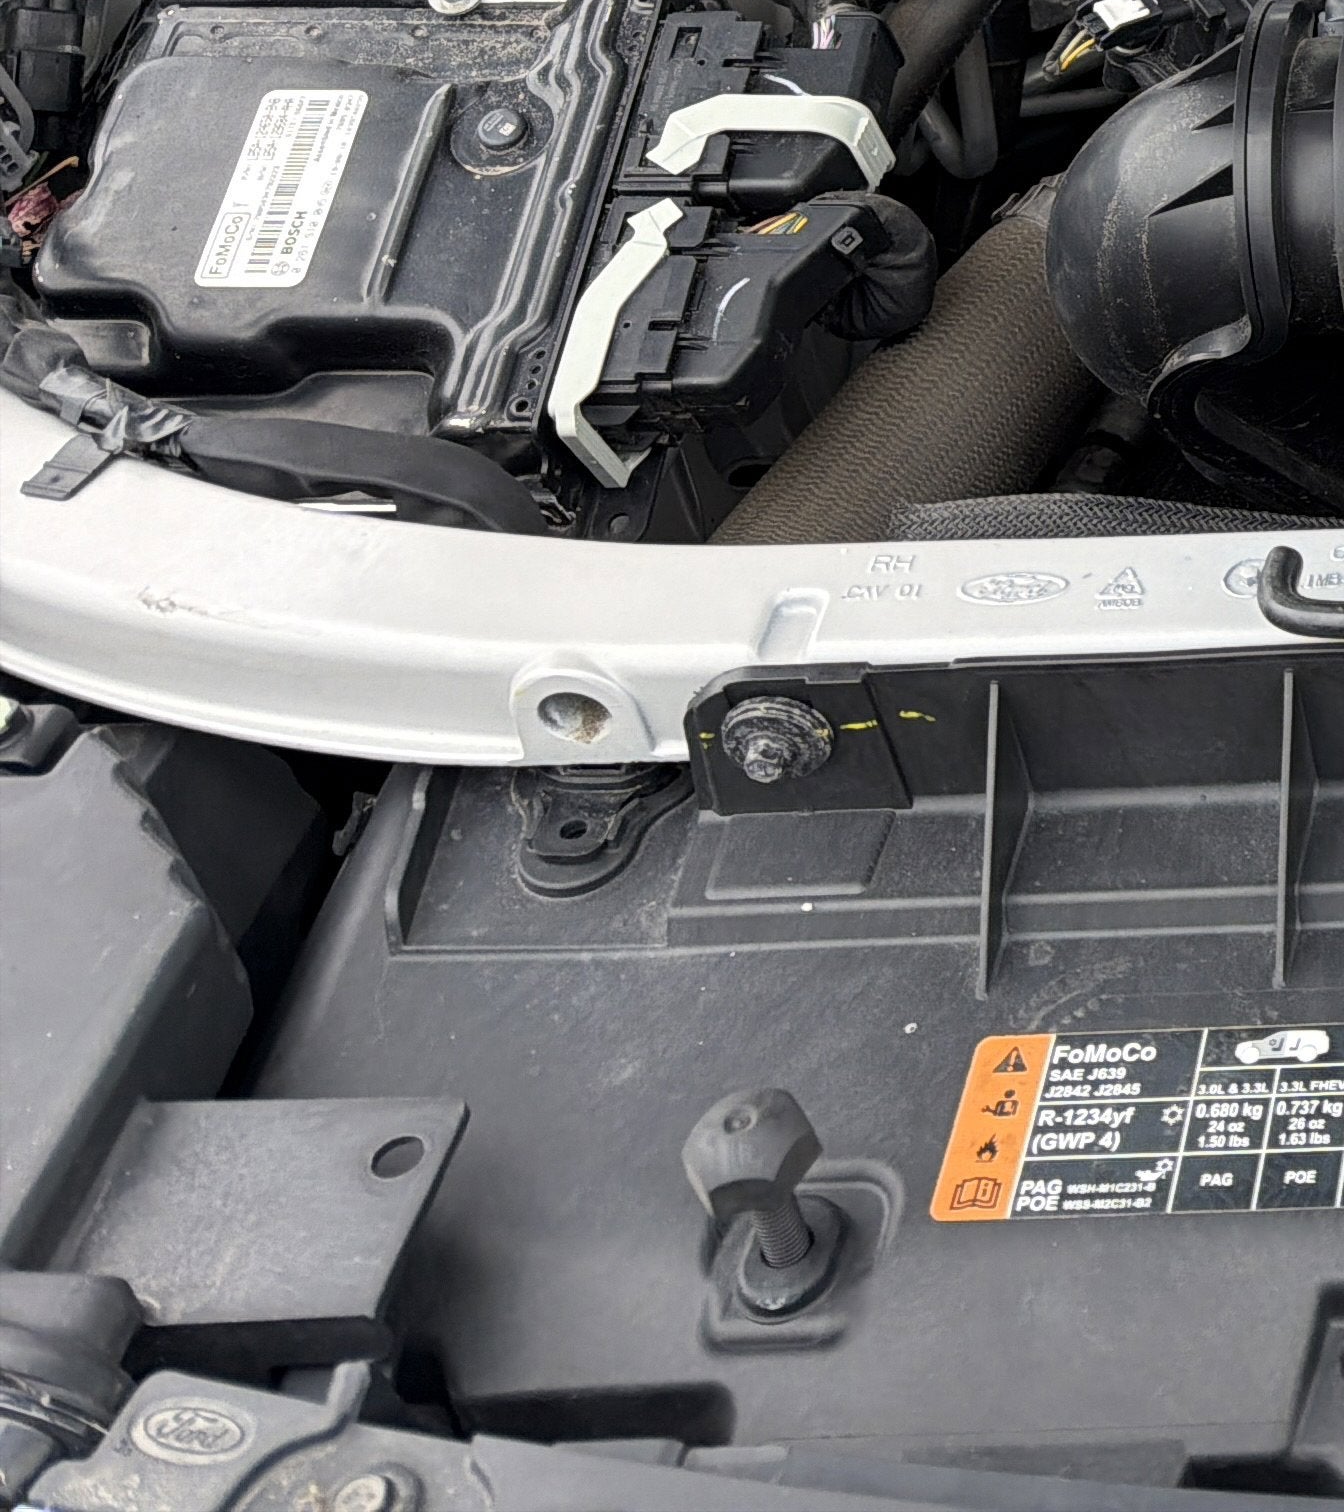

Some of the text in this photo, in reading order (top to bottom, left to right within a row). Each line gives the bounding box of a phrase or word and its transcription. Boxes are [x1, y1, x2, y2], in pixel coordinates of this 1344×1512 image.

[280, 210, 308, 255] BOSCH
[208, 215, 245, 275] FoMoCo
[869, 553, 917, 572] RH
[1052, 1042, 1157, 1065] FoMoCo
[1049, 1066, 1127, 1082] SAE J639
[1044, 1083, 1142, 1098] J2842 J2845
[1198, 1081, 1270, 1095] 3.0L & 3.3L
[1279, 1080, 1307, 1093] 3.3L
[1194, 1101, 1264, 1121] 0.680 kg
[1276, 1099, 1344, 1118] 0.737 kg
[1037, 1106, 1136, 1129] R-1234yf
[1286, 1117, 1327, 1131] 26 oz
[1206, 1120, 1246, 1134] 24 oz
[1031, 1131, 1121, 1155] (GWP 4)
[1197, 1134, 1251, 1148] 1.50 lbs
[1278, 1131, 1332, 1146] 1.63 lbs
[1199, 1172, 1234, 1187] PAG
[1282, 1169, 1318, 1185] POE
[1020, 1179, 1063, 1195] PAG
[1015, 1195, 1061, 1212] POE
[154, 1409, 235, 1449] Ford
